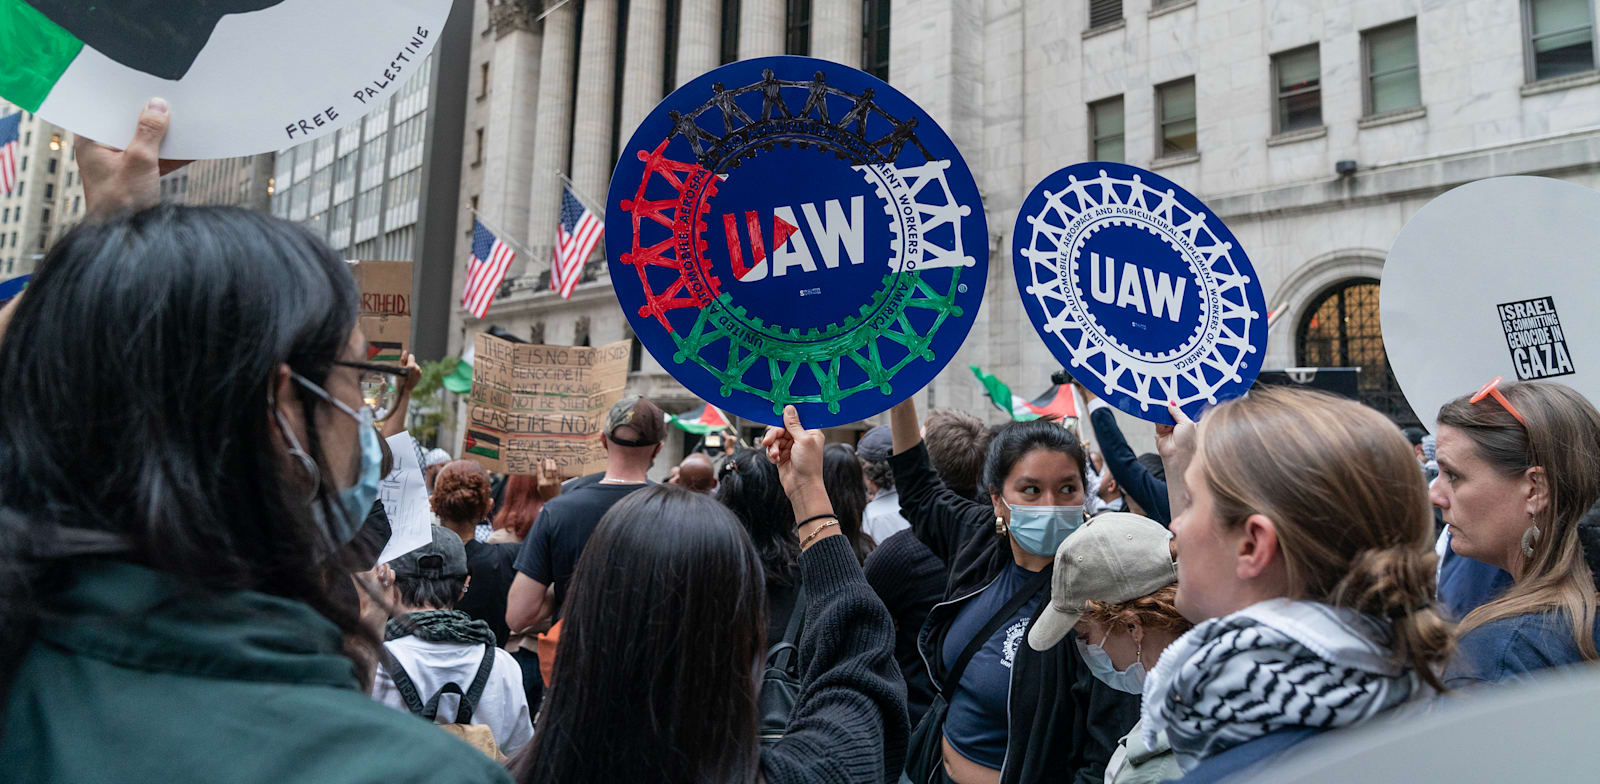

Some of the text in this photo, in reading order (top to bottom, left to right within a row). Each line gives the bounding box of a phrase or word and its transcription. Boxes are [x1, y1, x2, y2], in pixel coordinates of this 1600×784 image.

[285, 25, 429, 139] FREE PALESTINE
[899, 194, 918, 254] WORKERS
[1095, 207, 1113, 217] AND
[1116, 207, 1178, 237] AGRICULTURAL
[722, 195, 864, 282] UAW
[1063, 212, 1093, 247] AEROSPACE
[1179, 236, 1214, 284] IMPLEMENT
[1090, 251, 1187, 322] UAW
[362, 292, 412, 316] RTHEID!
[1210, 288, 1220, 331] WORKERS
[1498, 298, 1555, 320] ISRAEL
[1077, 314, 1104, 347] UNITED
[1206, 332, 1215, 344] OF
[1503, 313, 1558, 333] IS COMMITTING
[1507, 325, 1563, 349] GENOCIDE IN
[480, 334, 520, 365] THERE
[528, 349, 544, 364] IS
[545, 350, 569, 365] NO
[1174, 345, 1206, 370] AMERICA
[1513, 341, 1574, 380] GAZA
[479, 355, 494, 370] TO
[500, 362, 507, 375] A
[512, 396, 537, 408] NOT
[471, 404, 552, 433] CEASEFIRE
